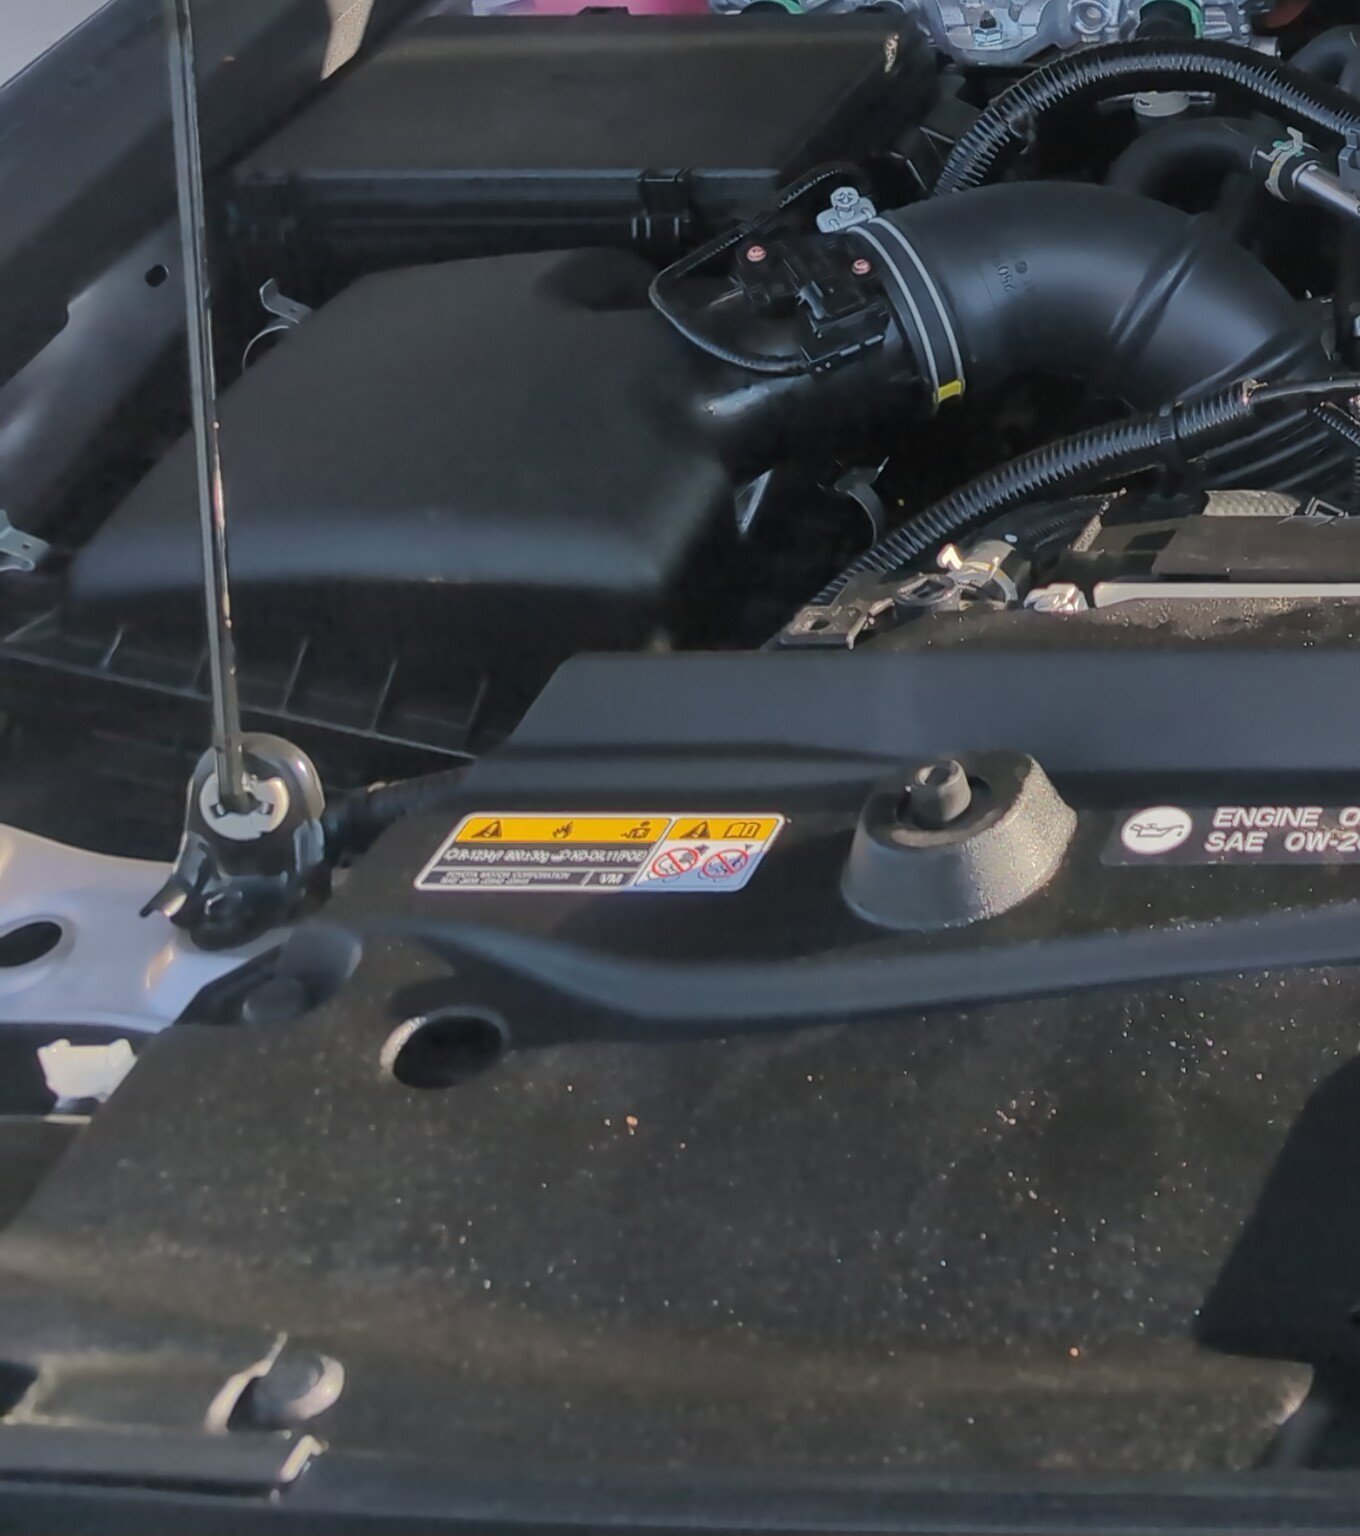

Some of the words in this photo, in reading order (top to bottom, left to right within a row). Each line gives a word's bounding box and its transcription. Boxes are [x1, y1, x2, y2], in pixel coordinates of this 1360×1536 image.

[1212, 807, 1323, 828] ENGINE
[1204, 830, 1268, 853] SAE
[598, 873, 624, 885] VM
